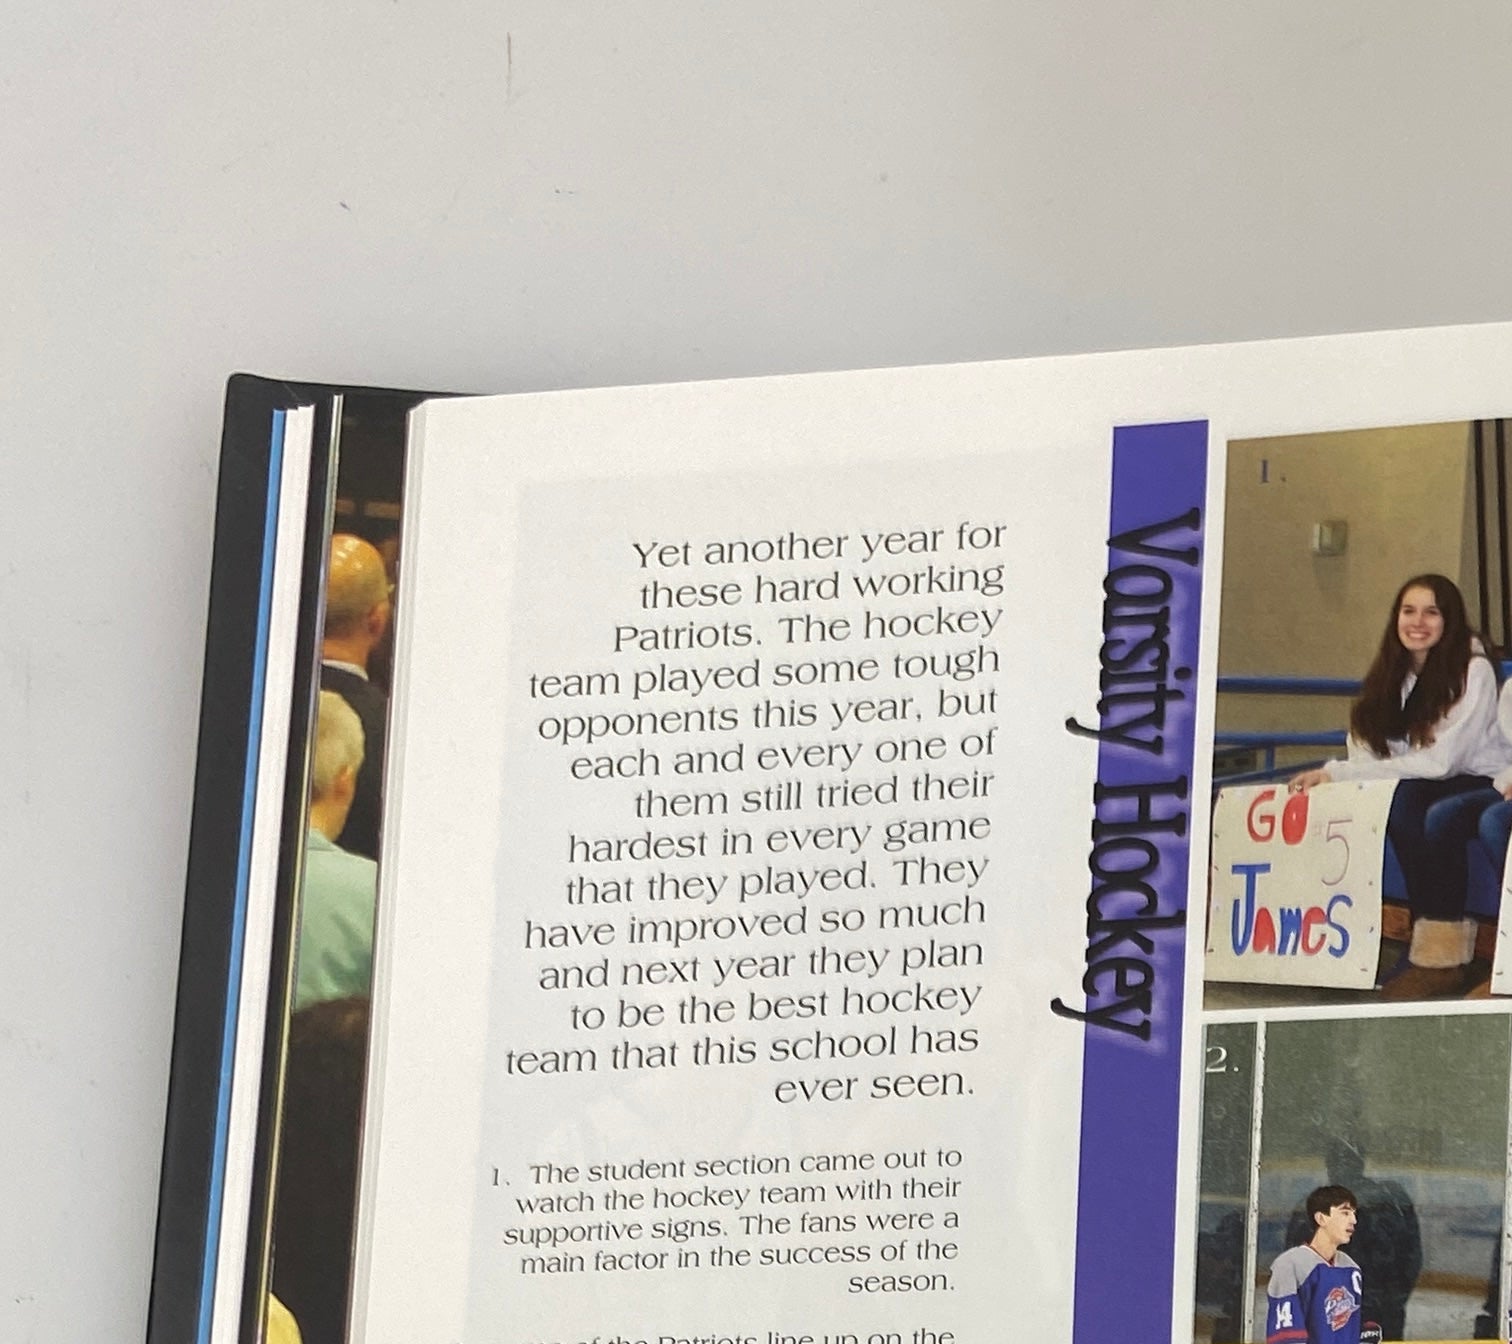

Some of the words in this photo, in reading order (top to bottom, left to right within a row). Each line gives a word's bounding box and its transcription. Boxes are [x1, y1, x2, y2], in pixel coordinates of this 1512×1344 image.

[631, 540, 693, 569] Yet
[703, 530, 850, 566] another
[860, 529, 945, 564] year
[955, 520, 1008, 551] for
[639, 579, 743, 610] these
[754, 569, 840, 605] hard
[852, 563, 1006, 599] working
[613, 620, 762, 653] Patriots.
[777, 610, 852, 644] The
[863, 605, 1004, 640] hockey
[1065, 506, 1200, 756] Varsity
[528, 672, 621, 699] team
[632, 655, 761, 701] played
[772, 657, 880, 687] some
[893, 643, 1001, 682] tough
[537, 705, 739, 747] opponents
[751, 698, 818, 730] this
[829, 696, 922, 732] year,
[937, 684, 999, 718] but
[569, 745, 661, 781] each
[671, 739, 745, 776] and
[756, 740, 864, 773] every
[873, 734, 947, 764] one
[959, 725, 999, 758] of
[1247, 790, 1310, 846] GO
[1051, 774, 1188, 1042] Hockey
[1206, 1046, 1240, 1073] 2.
